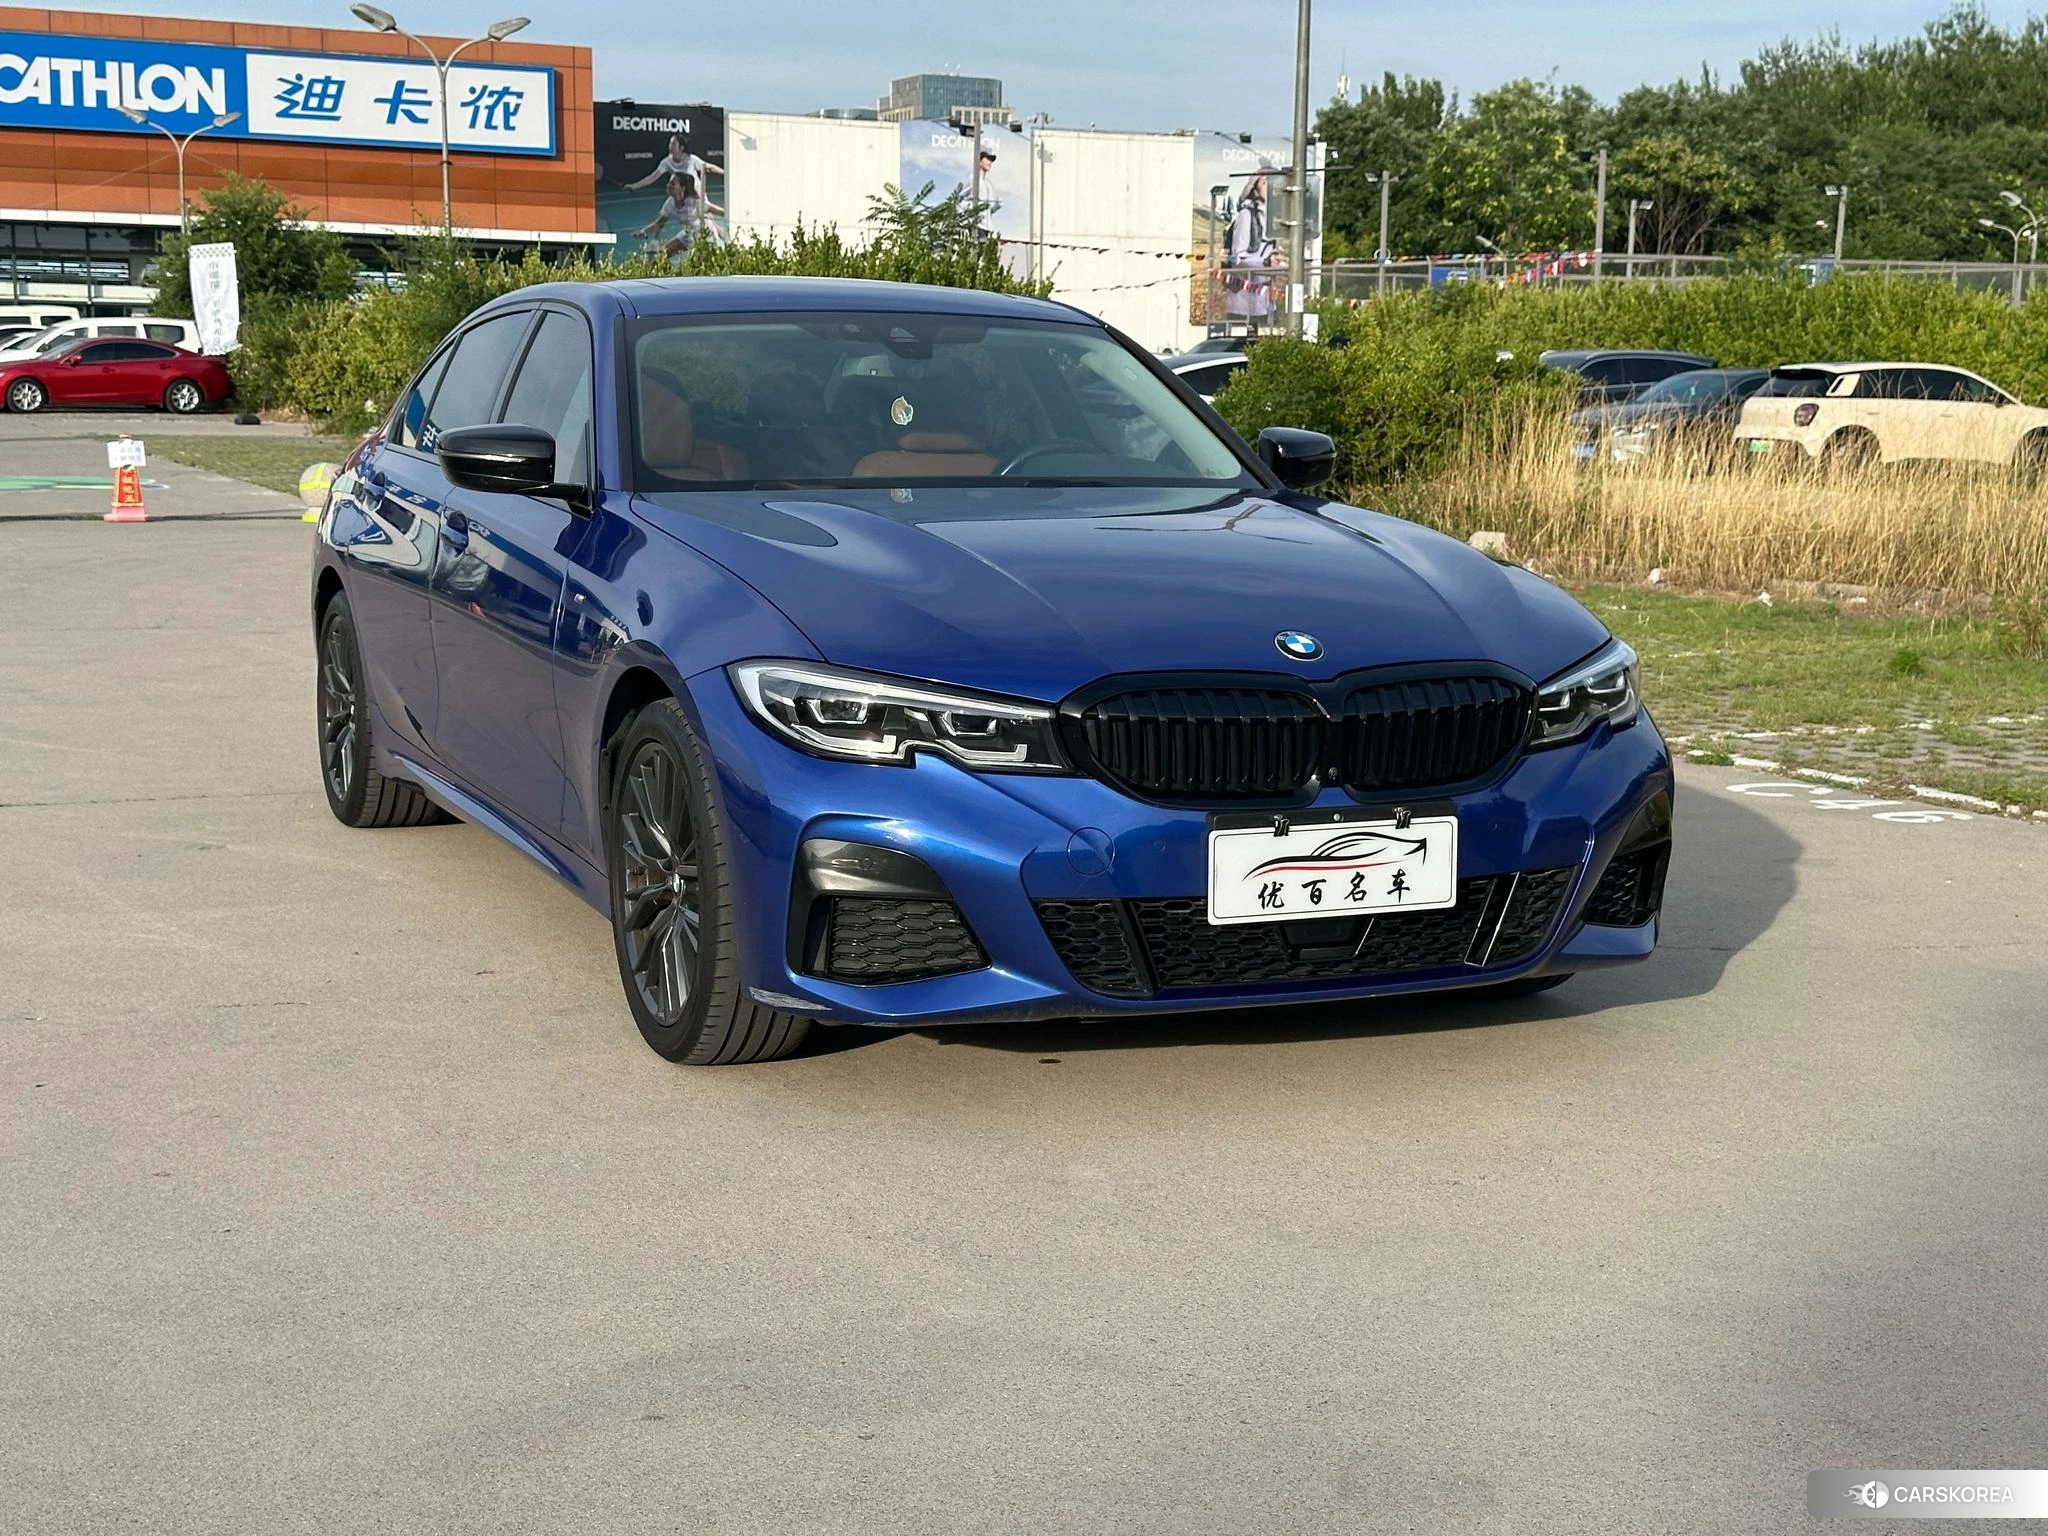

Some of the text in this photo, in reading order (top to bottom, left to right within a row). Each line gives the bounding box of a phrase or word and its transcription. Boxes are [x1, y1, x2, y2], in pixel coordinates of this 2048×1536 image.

[273, 73, 525, 131] 迪卡侬
[612, 115, 690, 133] DECATHLON
[1257, 868, 1411, 910] 优百名车
